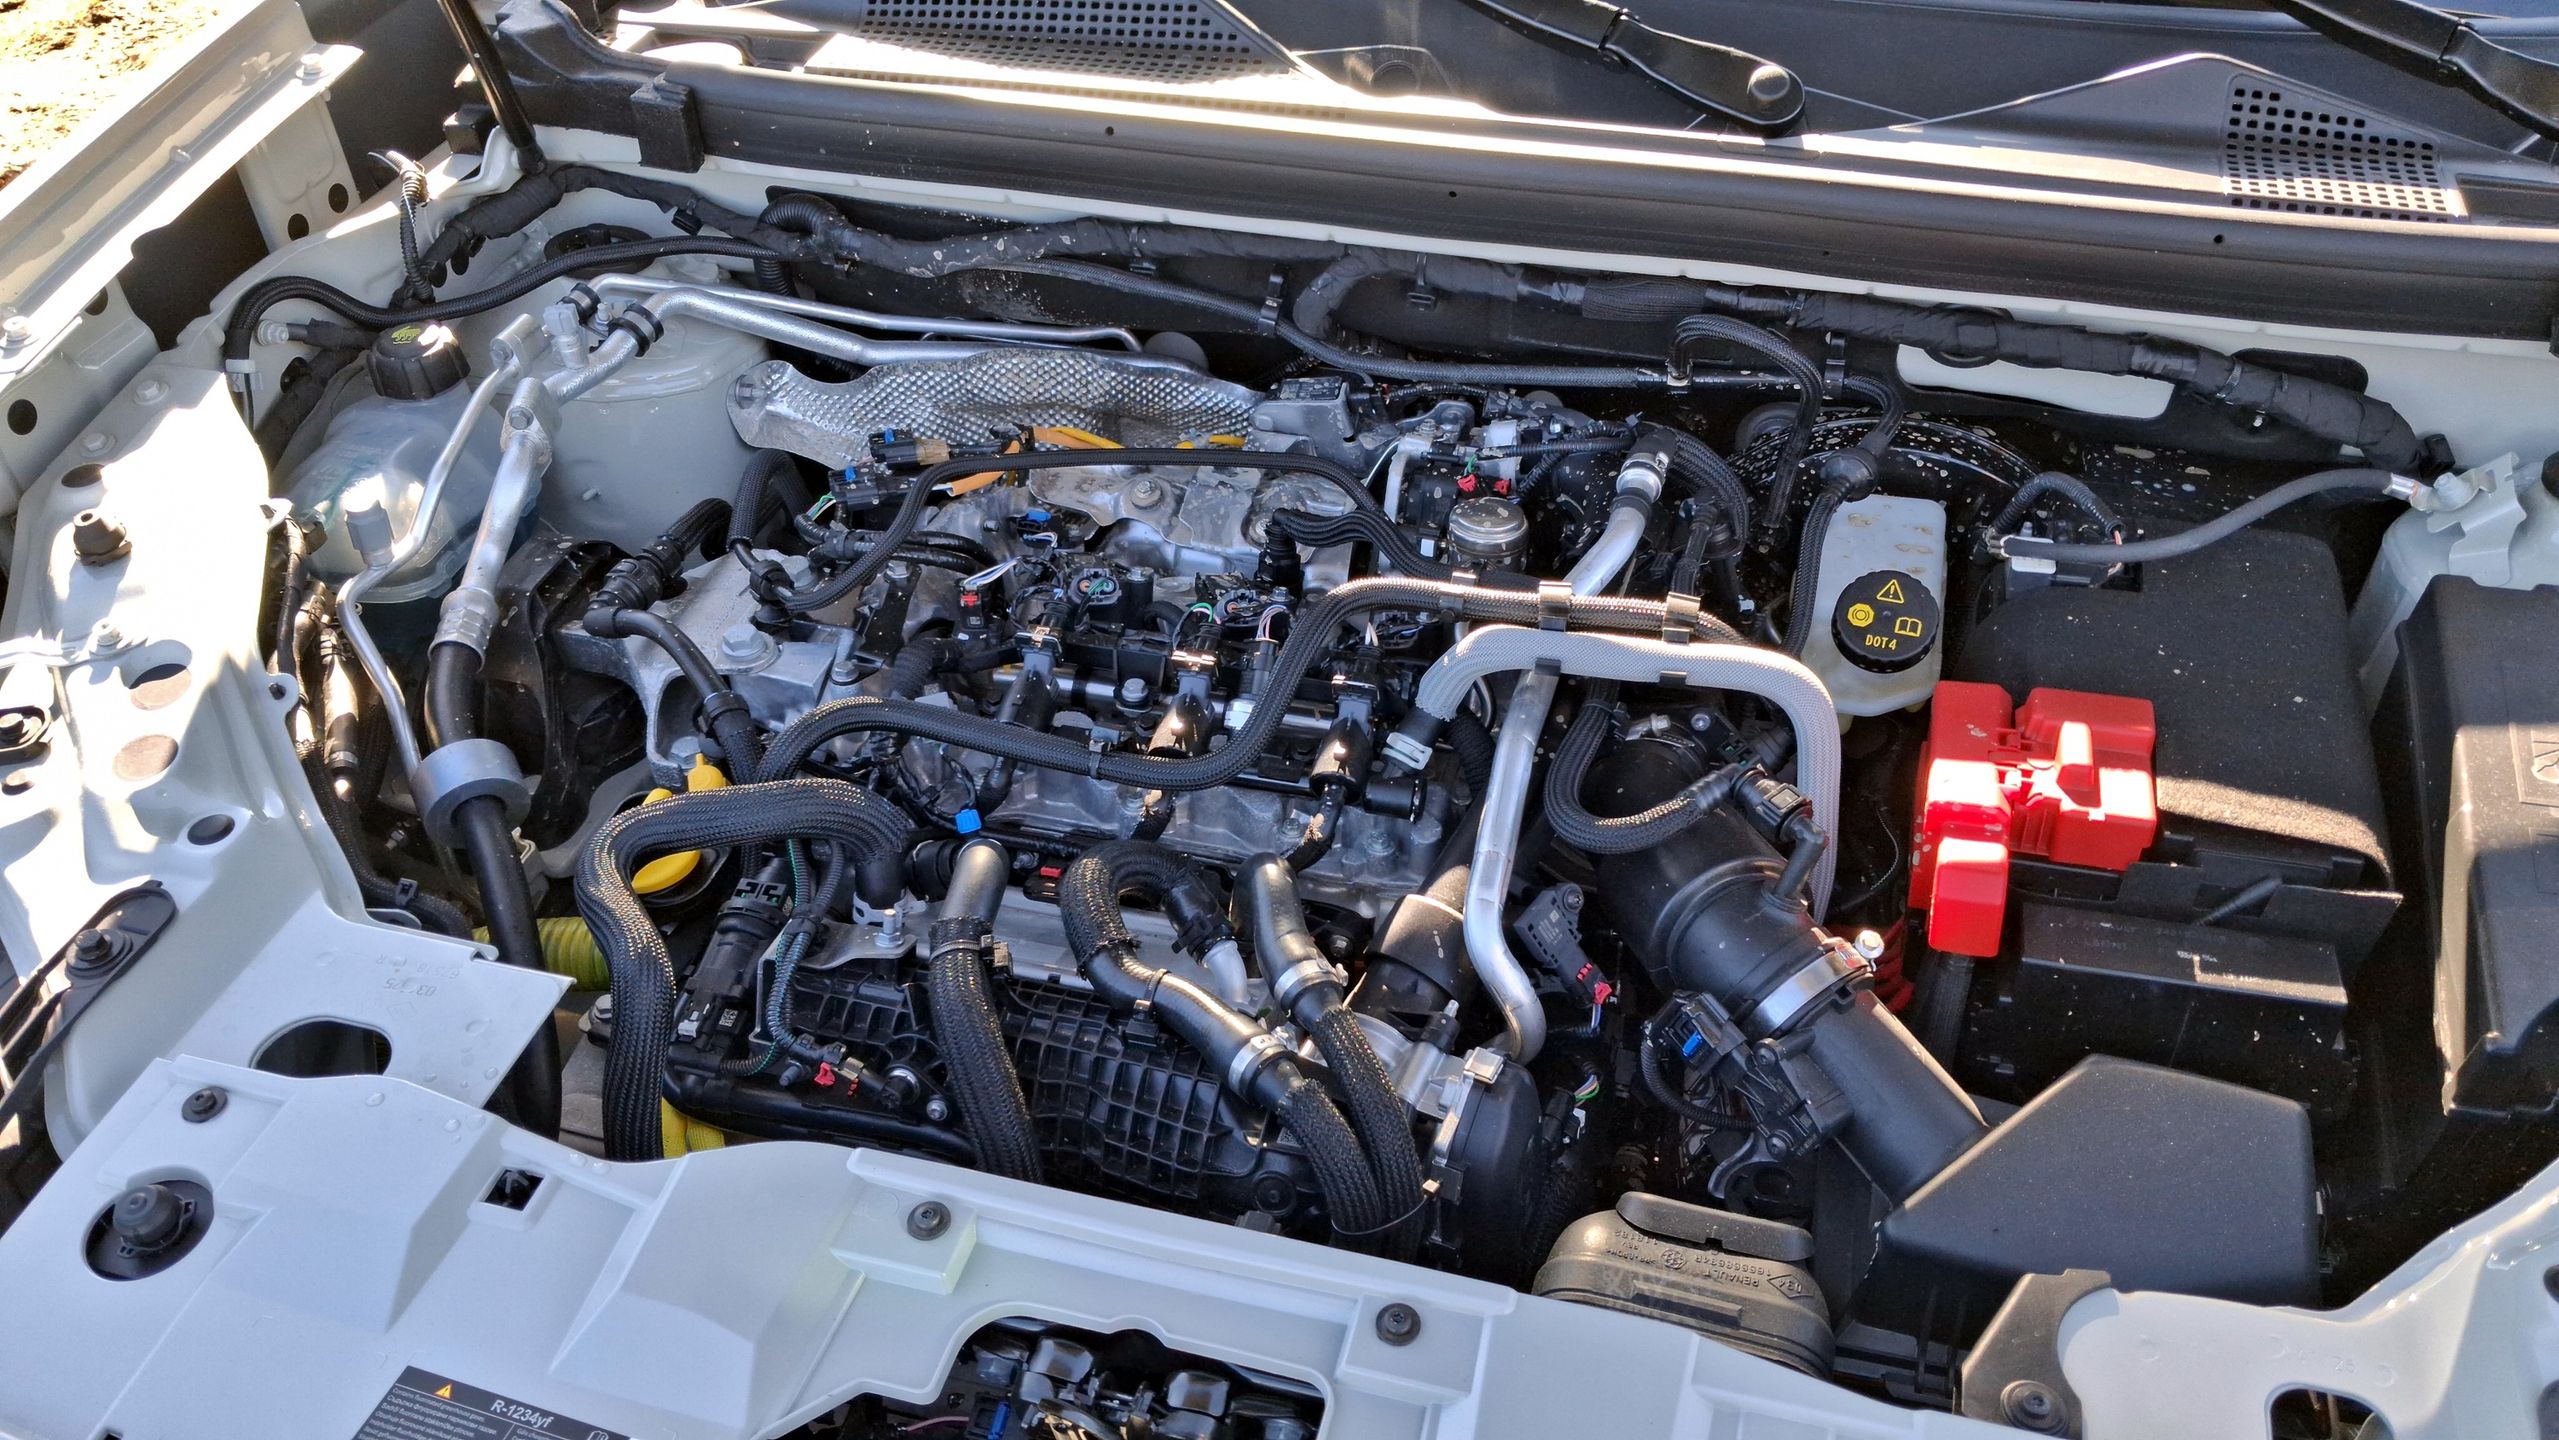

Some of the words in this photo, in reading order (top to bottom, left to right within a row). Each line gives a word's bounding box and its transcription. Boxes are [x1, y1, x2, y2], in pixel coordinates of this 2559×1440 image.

[1865, 634, 1888, 648] DOT
[1888, 639, 1897, 650] 4
[1702, 1269, 1760, 1288] RENAULT
[490, 1399, 554, 1428] R-1234yf
